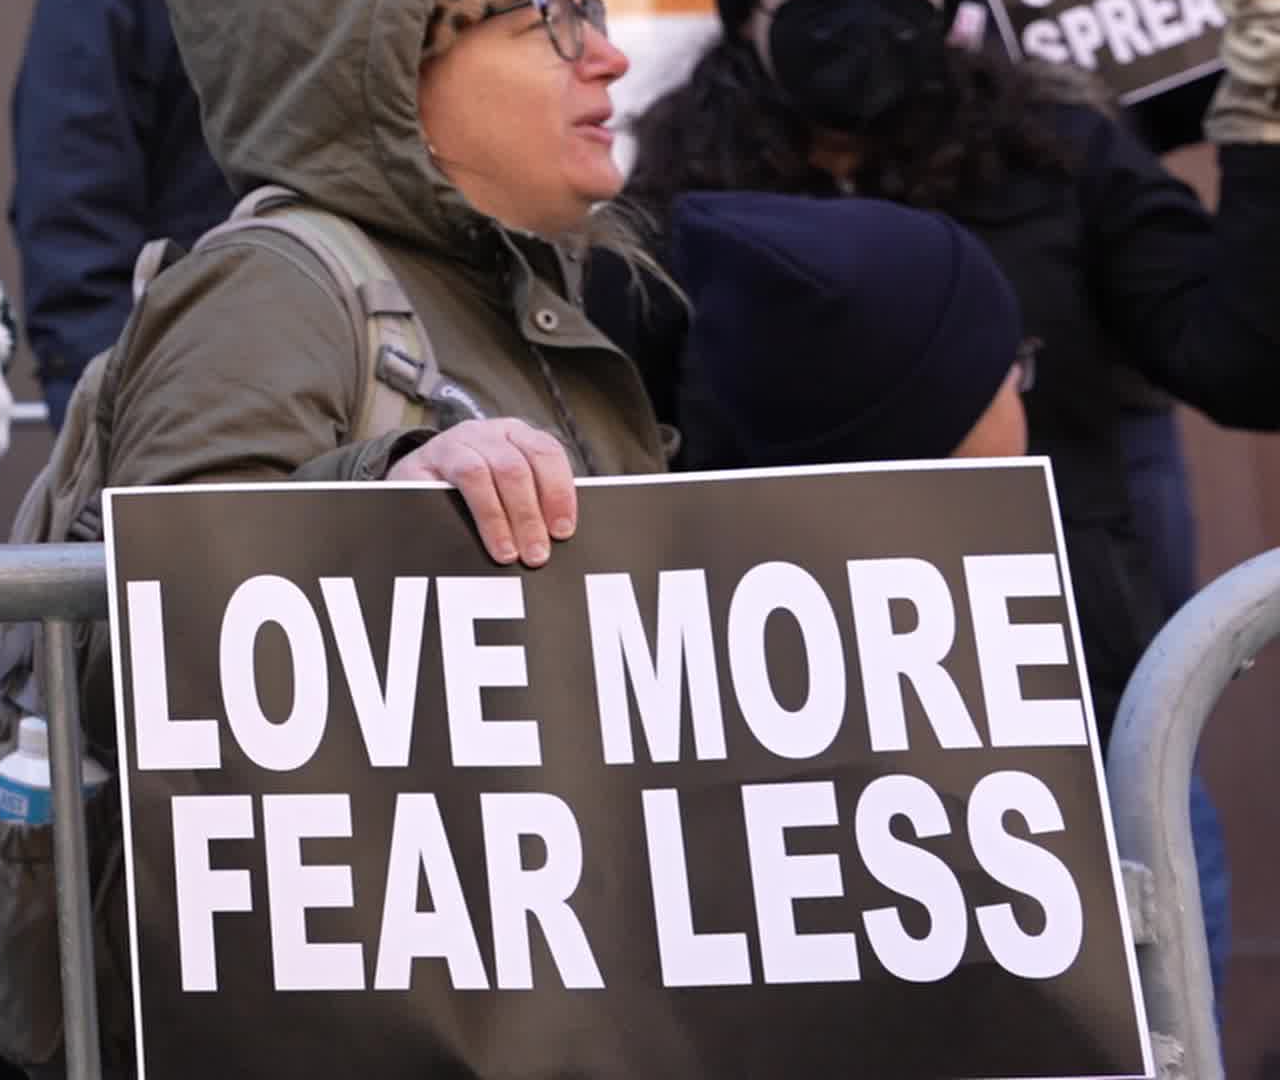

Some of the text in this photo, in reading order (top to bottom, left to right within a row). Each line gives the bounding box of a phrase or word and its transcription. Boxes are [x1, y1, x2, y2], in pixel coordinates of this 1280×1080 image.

[126, 552, 1089, 773] LOVE MORE
[171, 770, 1085, 993] FEAR LESS
